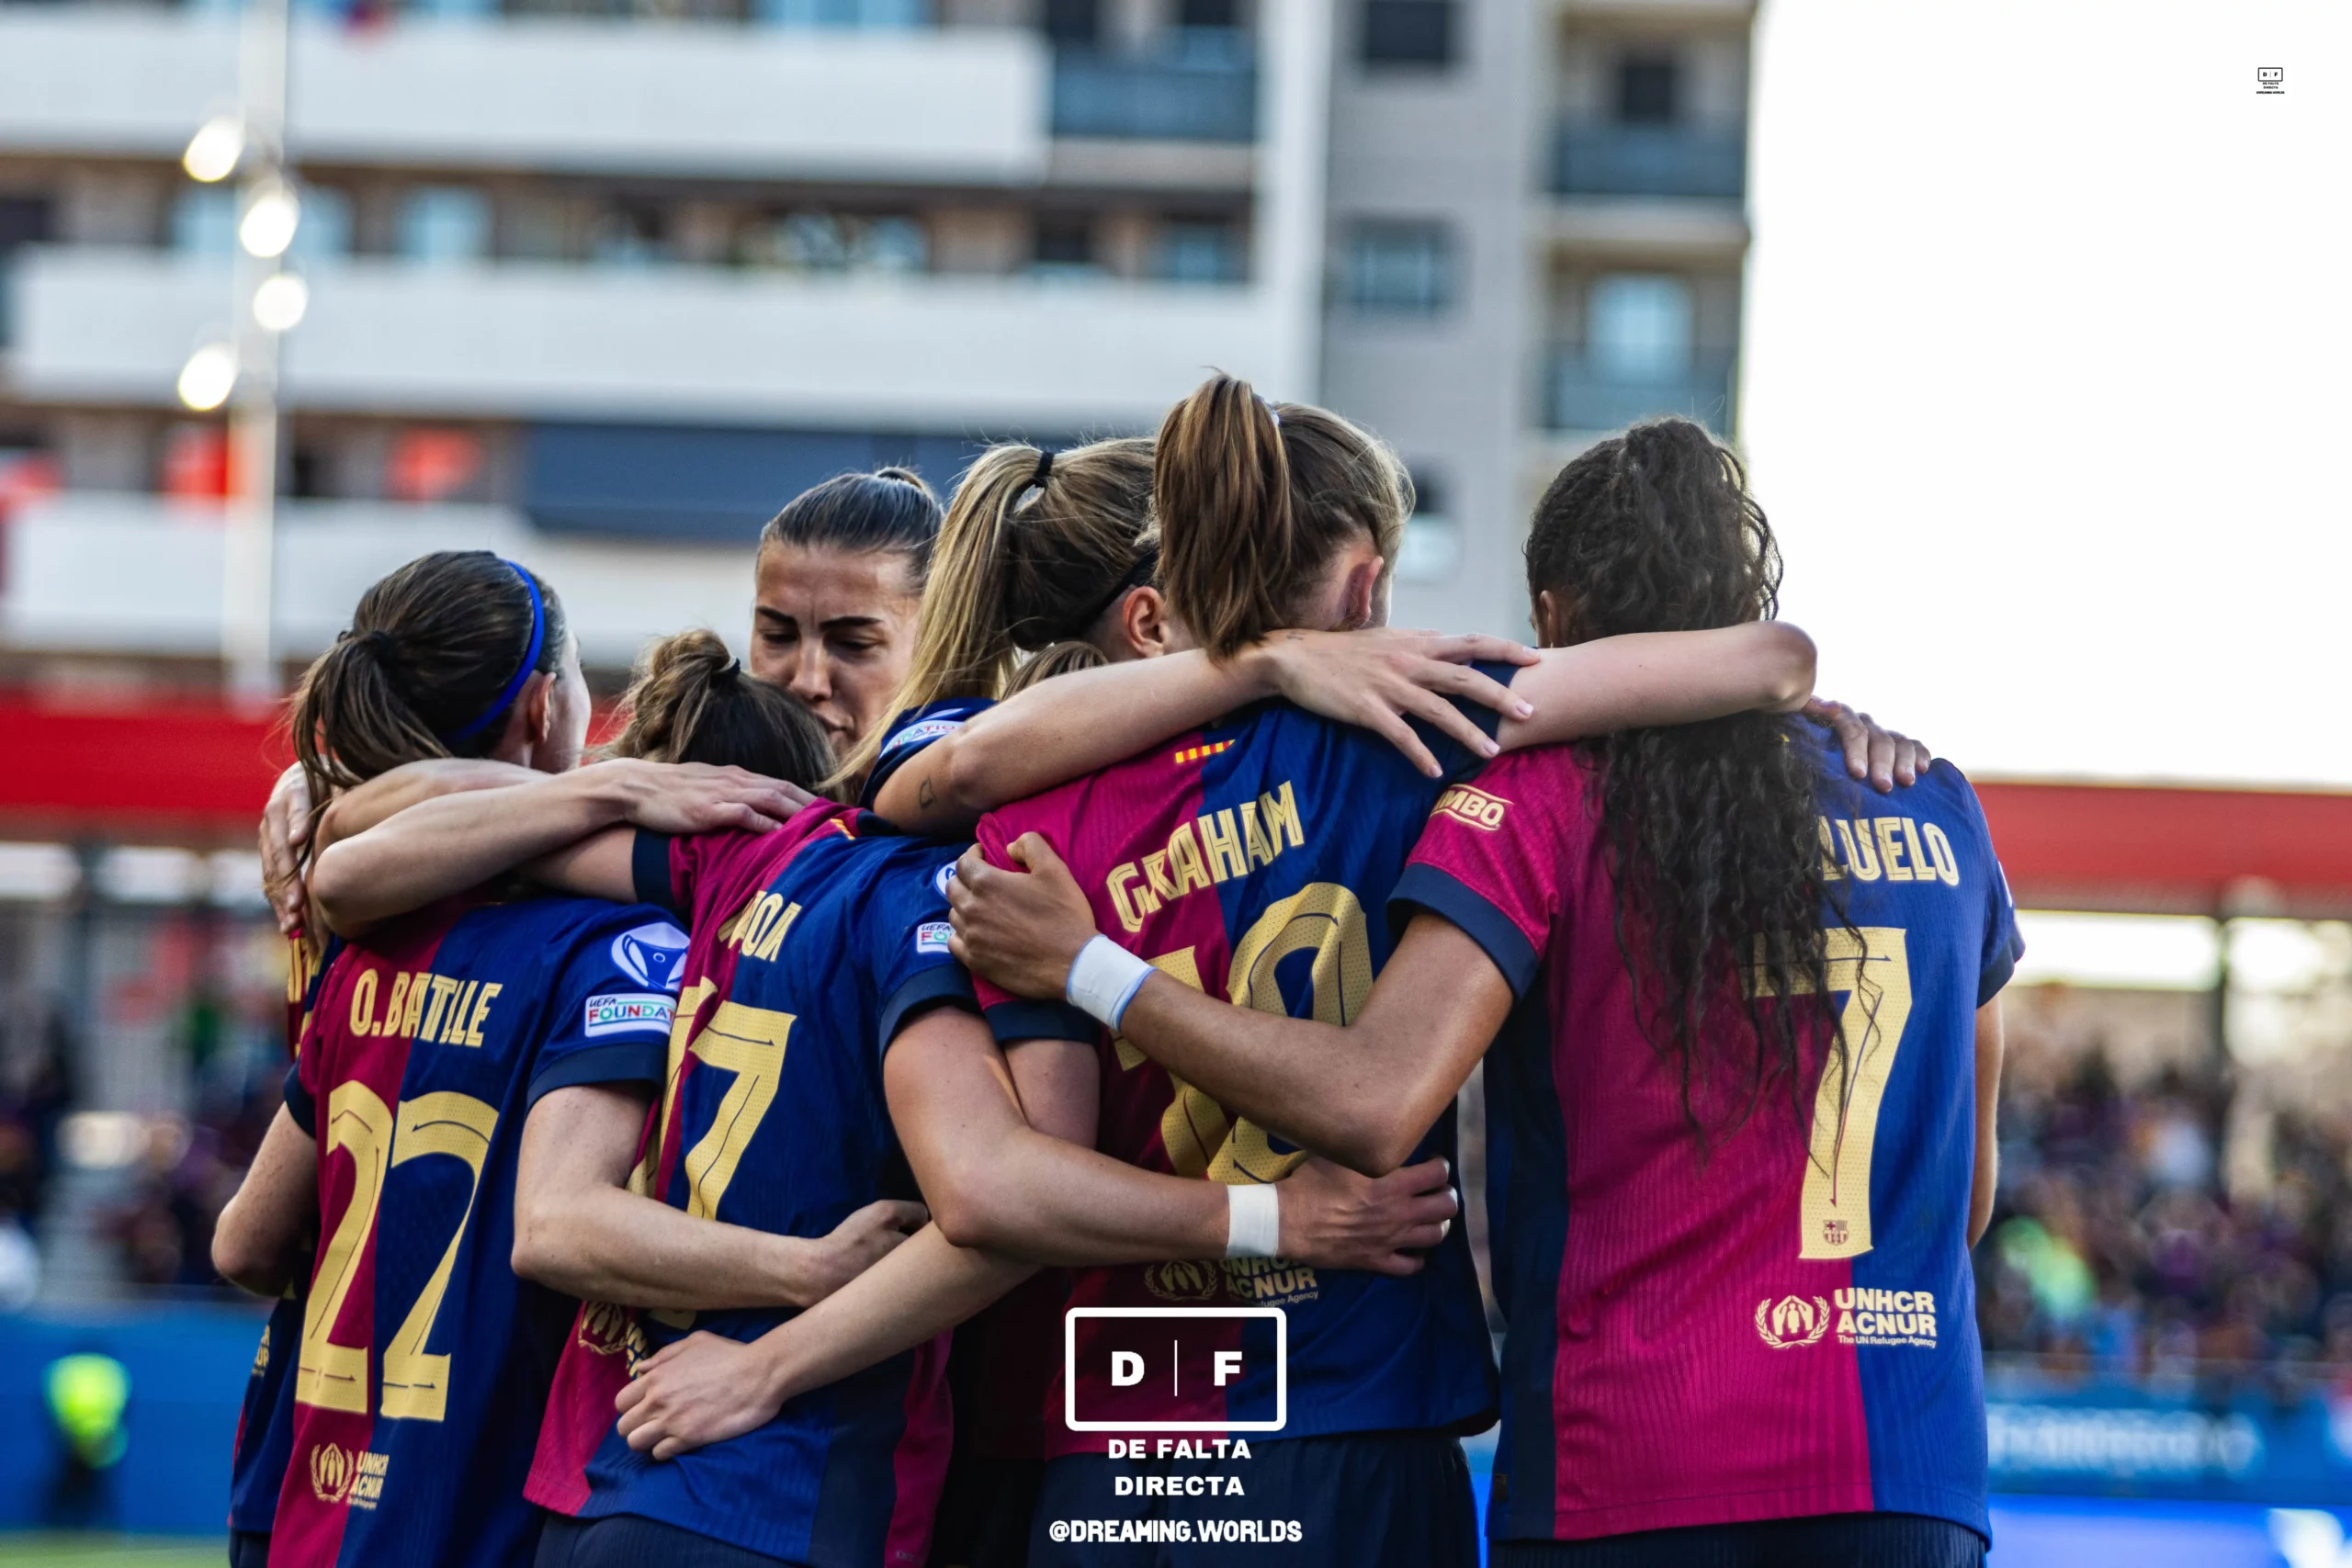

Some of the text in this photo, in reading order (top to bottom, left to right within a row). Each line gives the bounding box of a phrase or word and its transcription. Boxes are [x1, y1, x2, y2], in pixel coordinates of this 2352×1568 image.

[1106, 780, 1305, 933] GRAHAM
[589, 997, 616, 1008] UEFA
[1743, 926, 1913, 1259] 7
[295, 1079, 499, 1422] 22
[1286, 1291, 1318, 1303] Agency
[1834, 1287, 1936, 1314] UNHCR
[1837, 1311, 1938, 1337] ACNUR
[1838, 1335, 1937, 1349] The UN Refugee Agency
